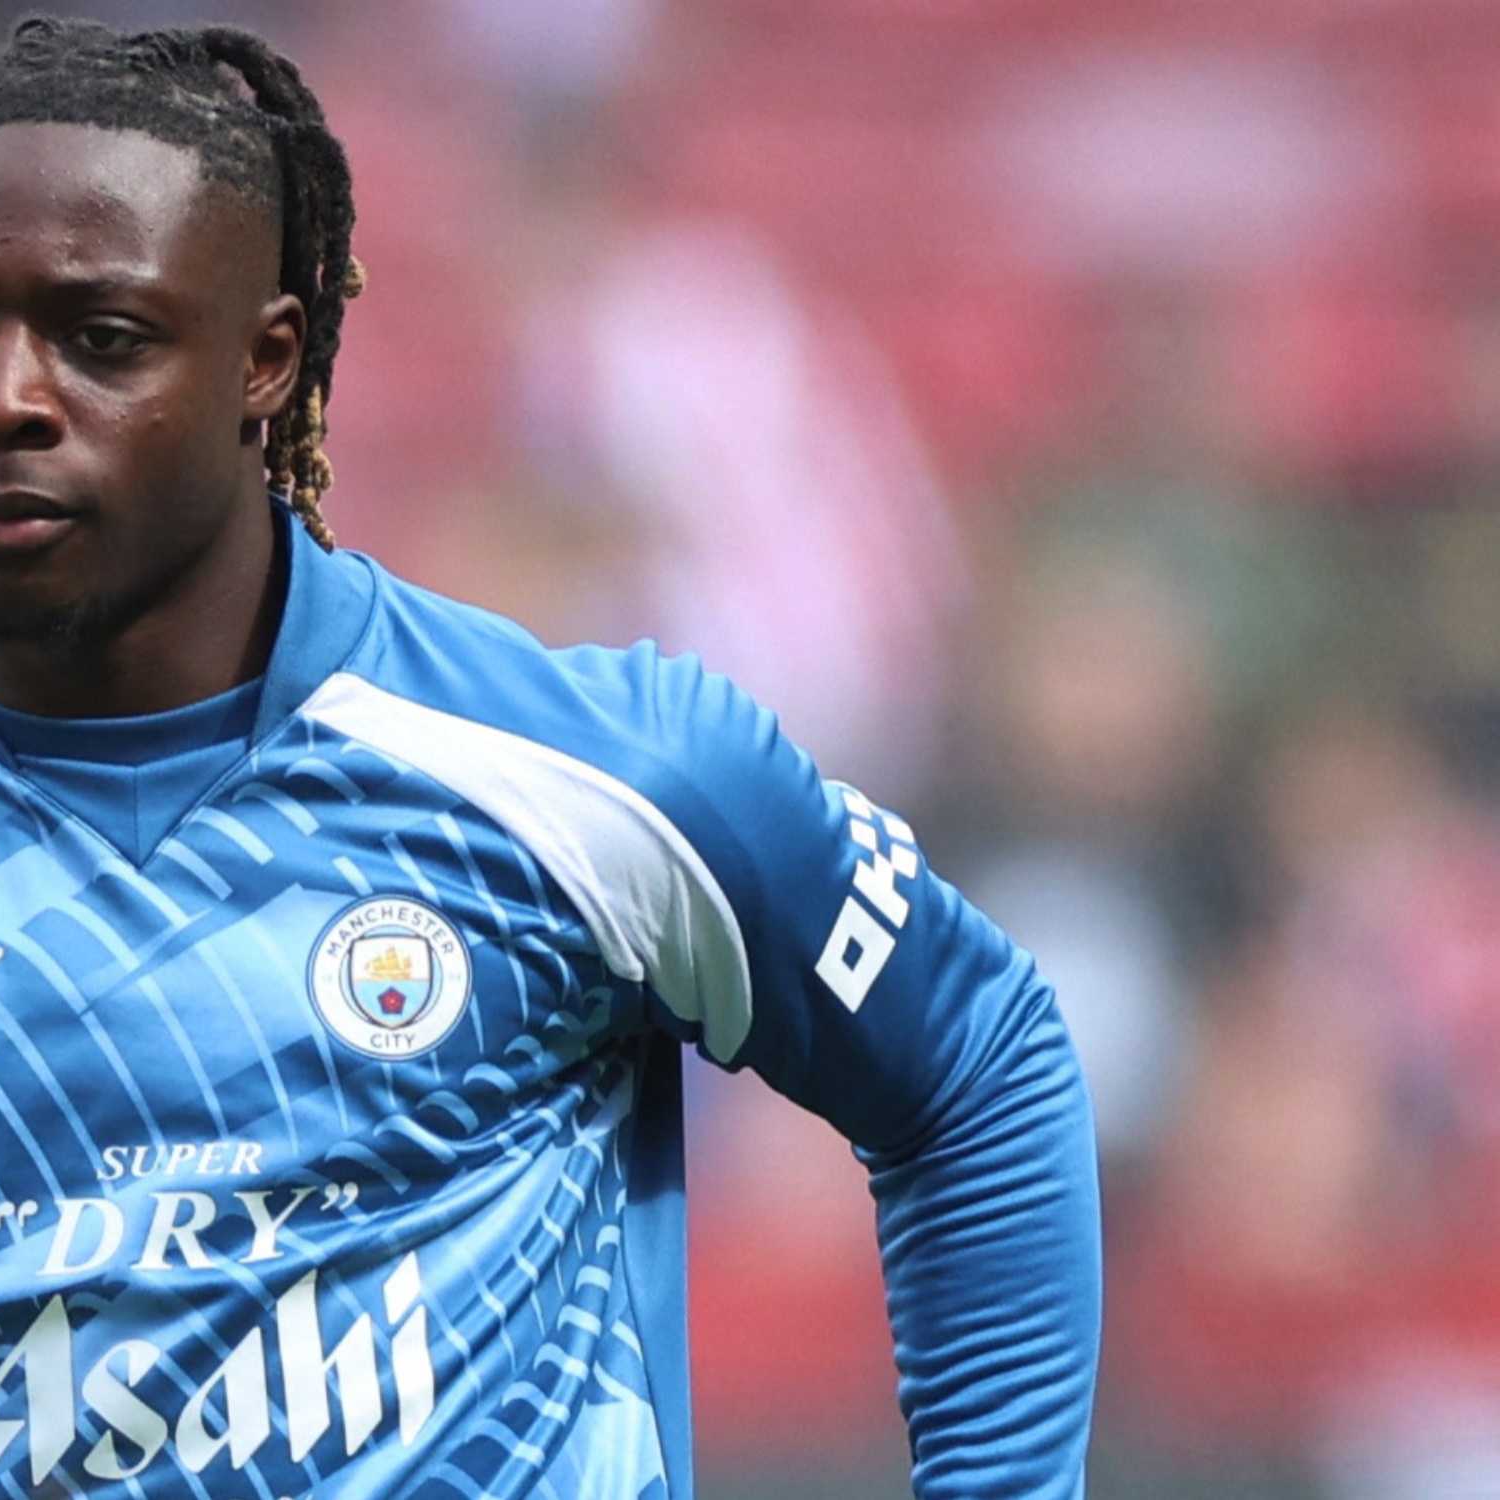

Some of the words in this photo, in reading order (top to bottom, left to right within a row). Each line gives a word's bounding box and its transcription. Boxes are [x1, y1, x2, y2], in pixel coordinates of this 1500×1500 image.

[328, 906, 453, 956] MANCHESTER
[370, 1033, 416, 1048] CITY
[97, 1142, 264, 1180] SUPER
